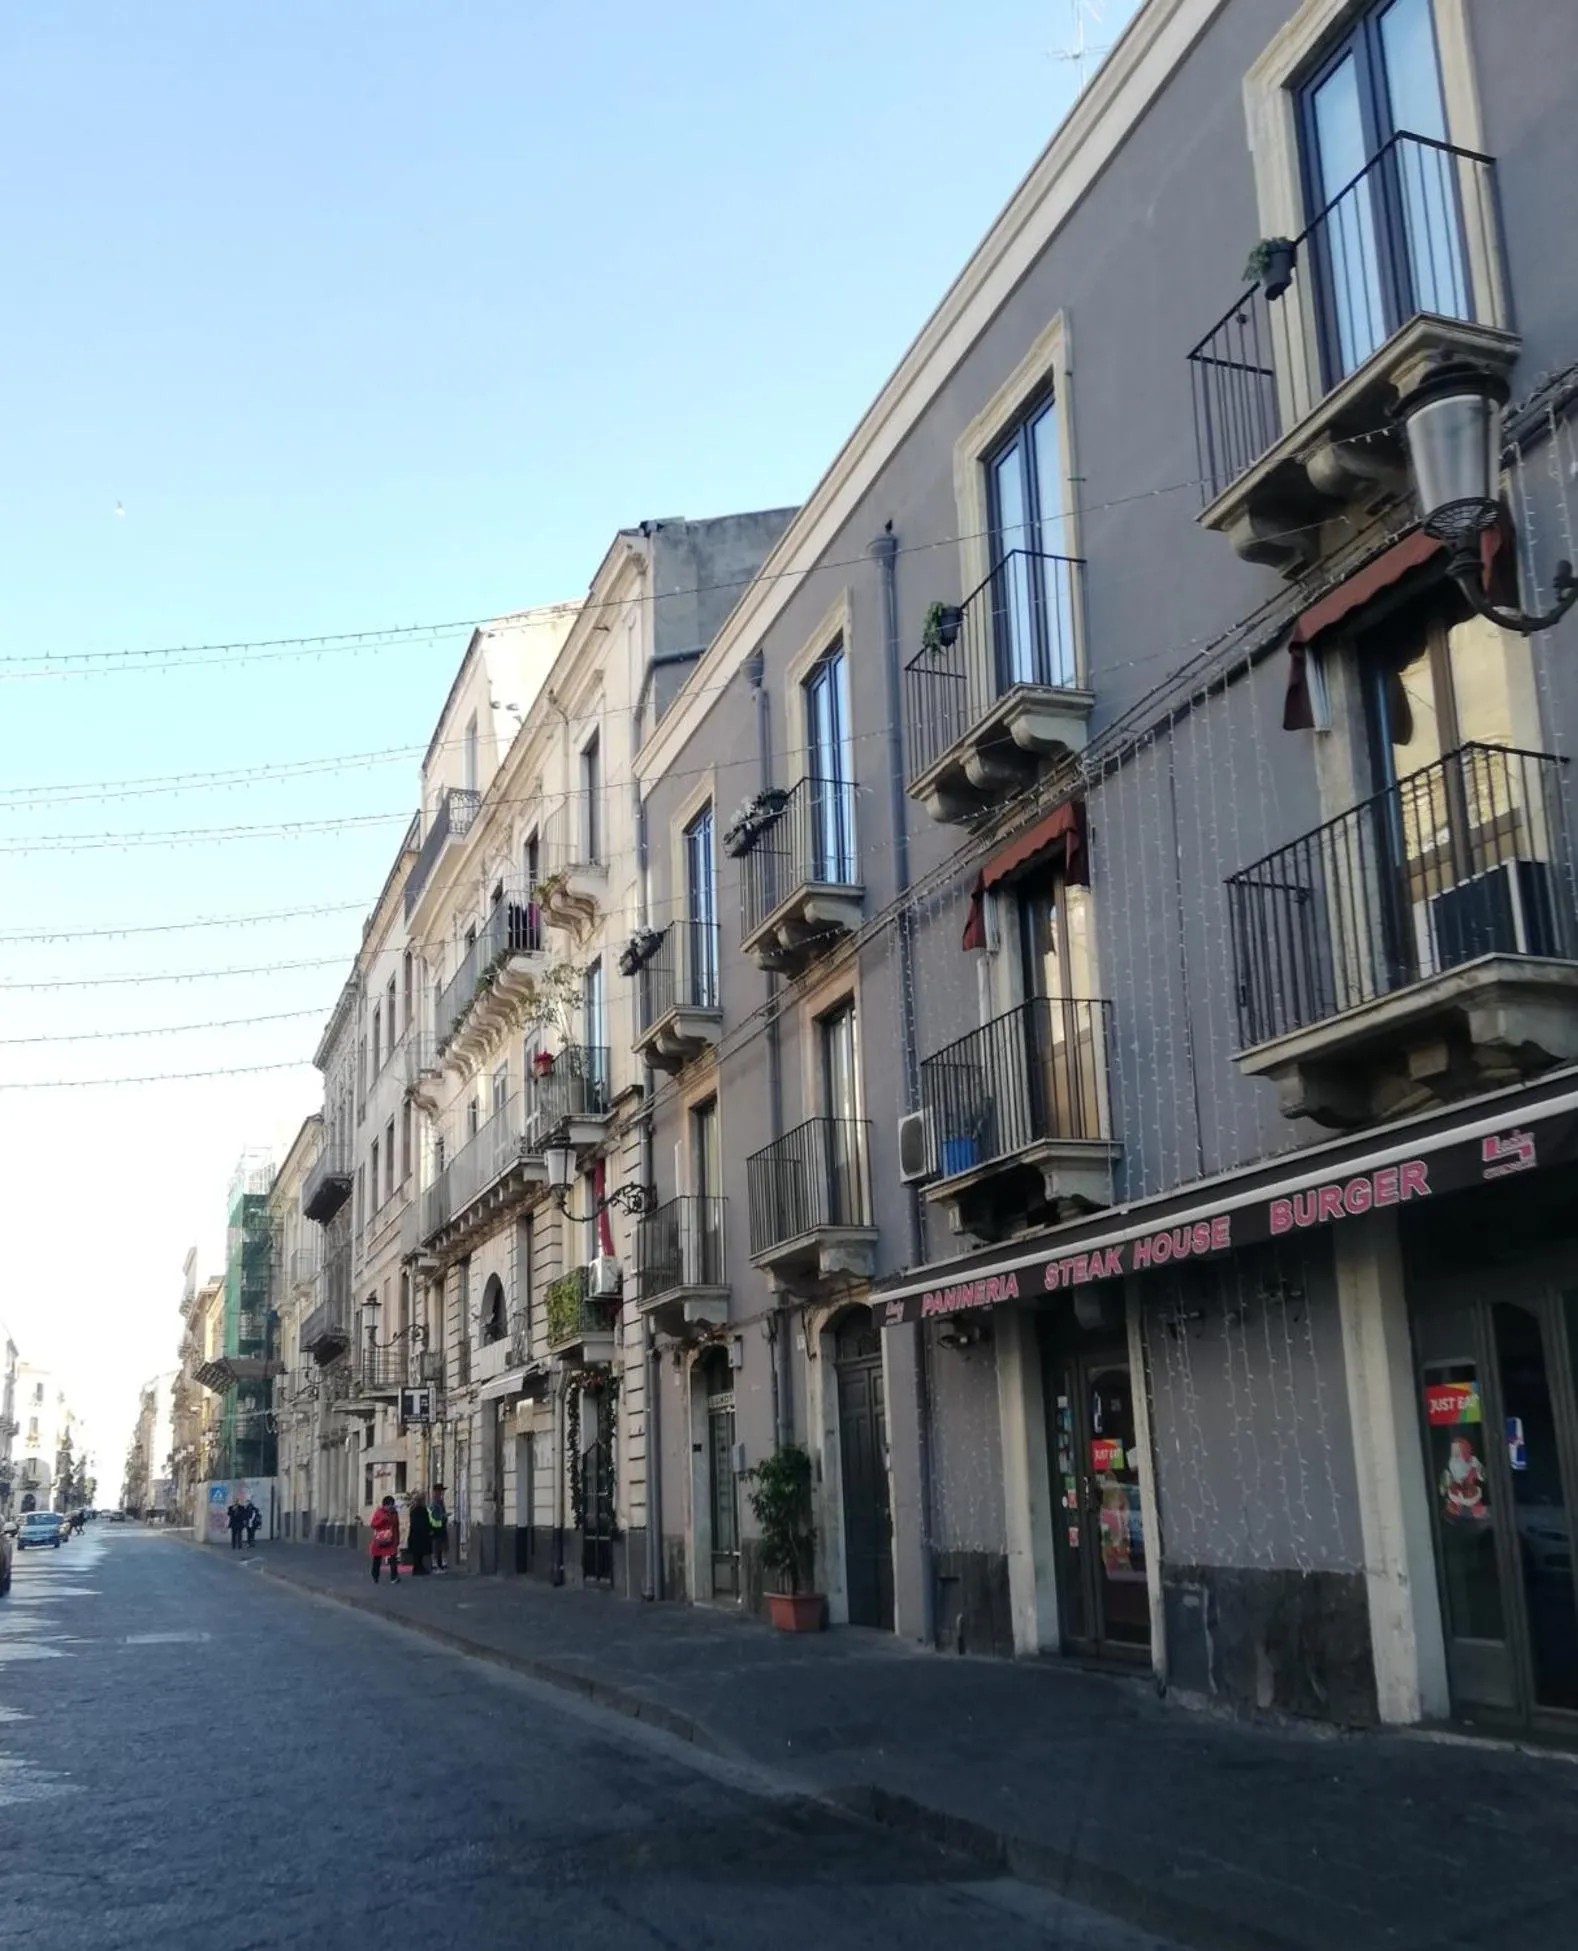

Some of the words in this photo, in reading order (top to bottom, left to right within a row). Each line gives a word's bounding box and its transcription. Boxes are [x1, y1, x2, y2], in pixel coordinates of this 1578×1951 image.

[921, 1272, 1019, 1318] PANINERIA
[1044, 1245, 1124, 1290] STEAK
[1133, 1215, 1231, 1270] HOUSE
[1270, 1160, 1432, 1235] BURGER
[1429, 1397, 1456, 1414] JUST
